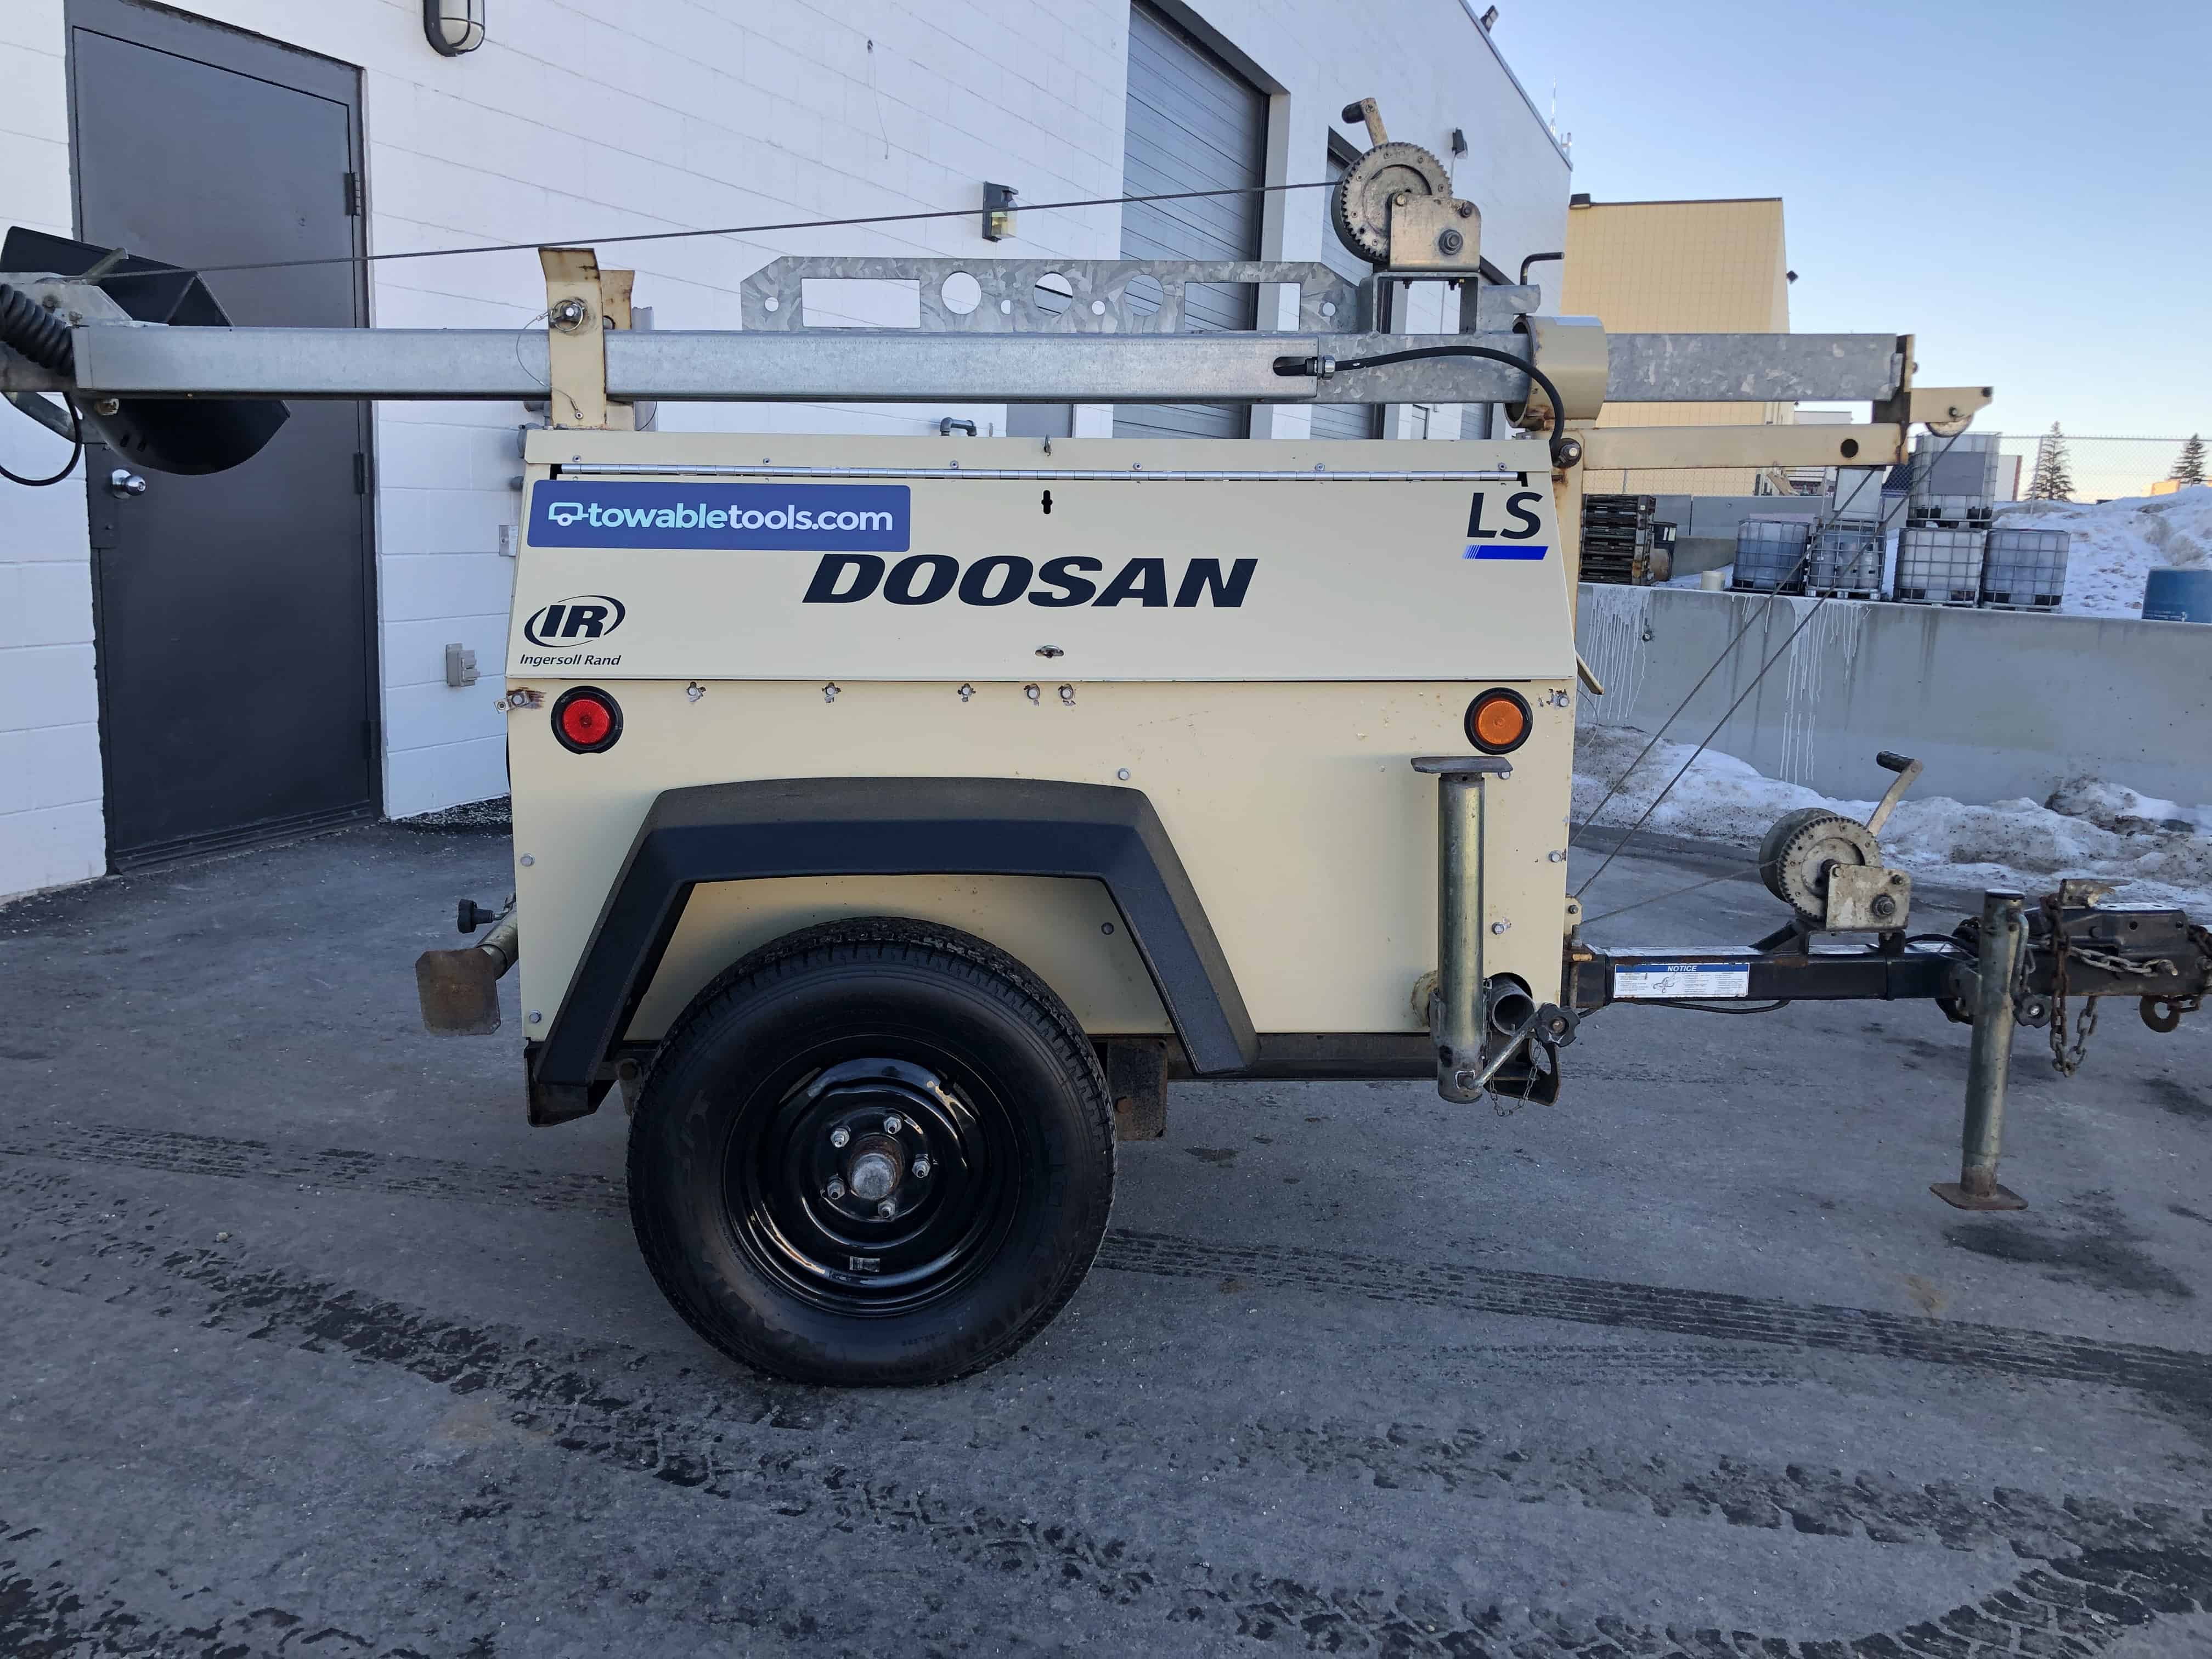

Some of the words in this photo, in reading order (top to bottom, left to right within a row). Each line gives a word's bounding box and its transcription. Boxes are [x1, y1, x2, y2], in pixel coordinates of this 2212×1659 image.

[588, 503, 893, 531] towabletools.com
[1466, 492, 1543, 539] LS
[802, 554, 1259, 607] DOOSAN
[539, 605, 608, 638] IR
[520, 654, 582, 667] Ingersoll
[584, 654, 622, 666] Rand
